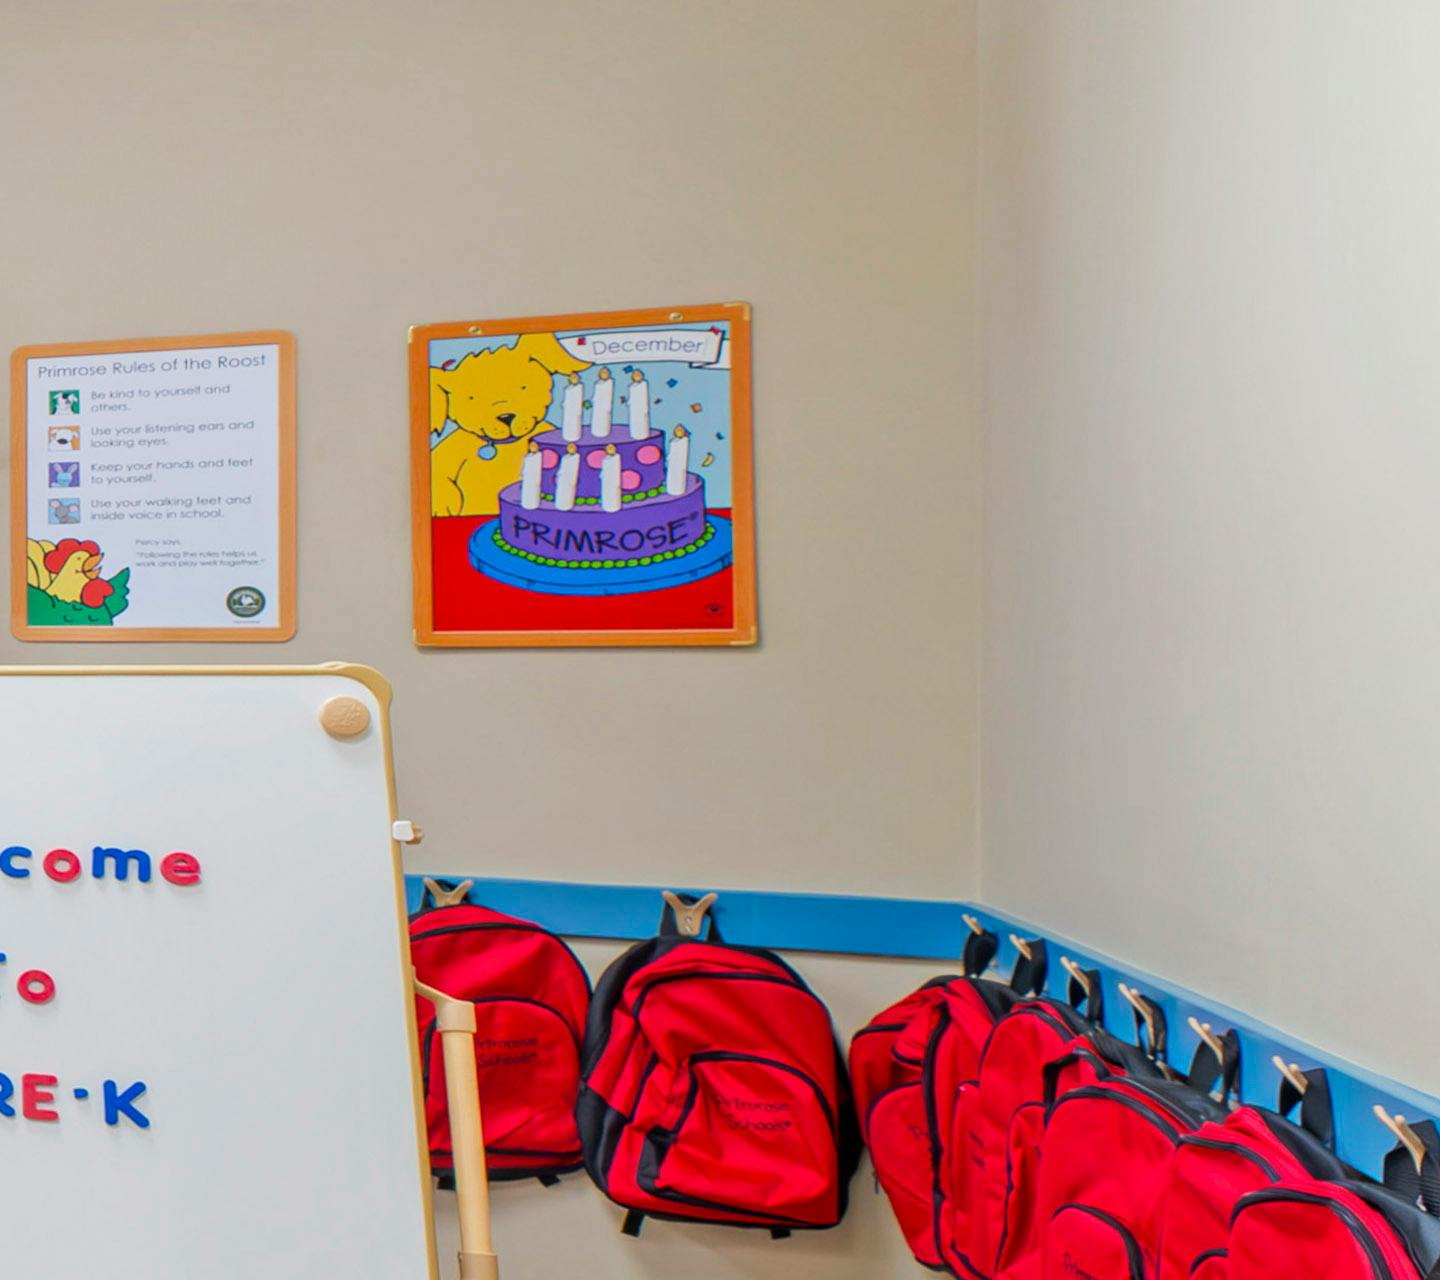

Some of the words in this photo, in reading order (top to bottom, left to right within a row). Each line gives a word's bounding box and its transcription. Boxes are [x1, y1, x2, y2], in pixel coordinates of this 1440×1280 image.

[592, 336, 704, 355] December
[38, 365, 107, 378] Primrose
[113, 361, 155, 375] Rules
[161, 359, 177, 371] of
[184, 357, 212, 370] the
[218, 354, 266, 368] Roost
[91, 391, 105, 400] Be
[109, 389, 134, 398] kind
[139, 388, 150, 397] to
[154, 386, 201, 398] yourself
[205, 384, 230, 394] and
[91, 403, 131, 413] others.
[91, 426, 111, 436] Use
[116, 426, 141, 436] your
[145, 423, 195, 435] listening
[199, 422, 225, 431] ears
[229, 420, 255, 430] and
[91, 437, 134, 449] looking
[139, 437, 168, 448] eyes.
[91, 463, 123, 474] Keep
[127, 462, 153, 472] your
[156, 459, 194, 469] hands
[199, 458, 224, 468] and
[228, 457, 253, 467] feet
[91, 475, 103, 484] to
[107, 473, 156, 486] yourself.
[91, 499, 111, 509] Use
[116, 499, 141, 510] your
[145, 496, 192, 508] walking
[197, 495, 221, 505] feet
[226, 495, 251, 504] and
[91, 510, 125, 521] inside
[129, 511, 162, 520] voice
[166, 509, 177, 519] in
[181, 508, 224, 519] school.
